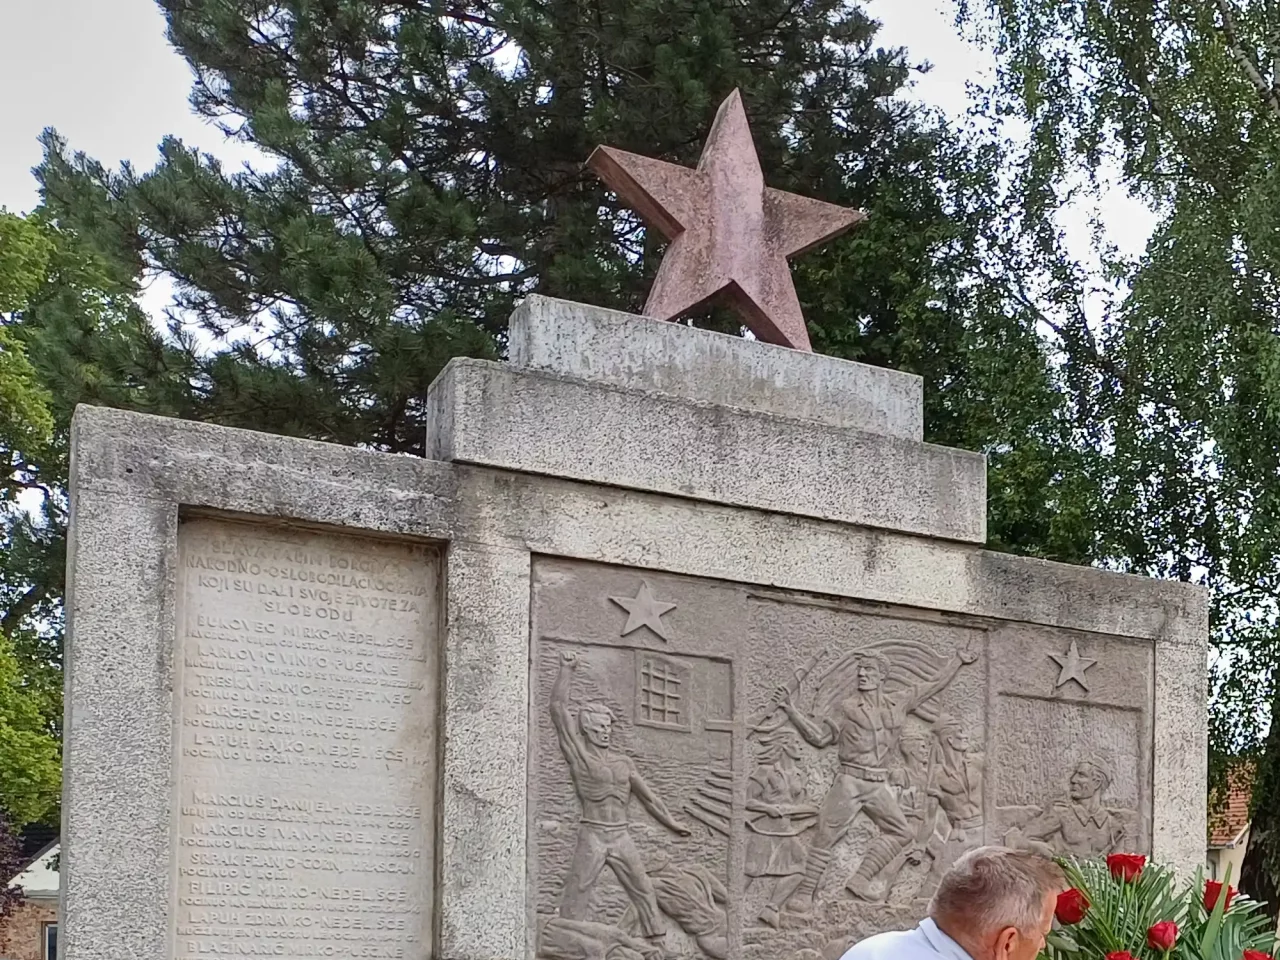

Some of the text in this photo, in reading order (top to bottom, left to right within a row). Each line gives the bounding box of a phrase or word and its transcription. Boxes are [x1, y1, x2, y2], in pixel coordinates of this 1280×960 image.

[198, 575, 229, 593] KOJI
[234, 580, 253, 593] SU
[258, 583, 294, 598] DALI
[300, 588, 341, 605] SVOJE
[400, 599, 420, 614] ZA
[265, 601, 352, 622] SLOBODU
[194, 733, 251, 750] LAPUH
[181, 807, 224, 819] UBIJEN
[228, 810, 245, 820] OD
[191, 823, 266, 838] MARCIUŠ
[190, 853, 239, 867] SRPAK
[188, 912, 240, 925] LAPUH
